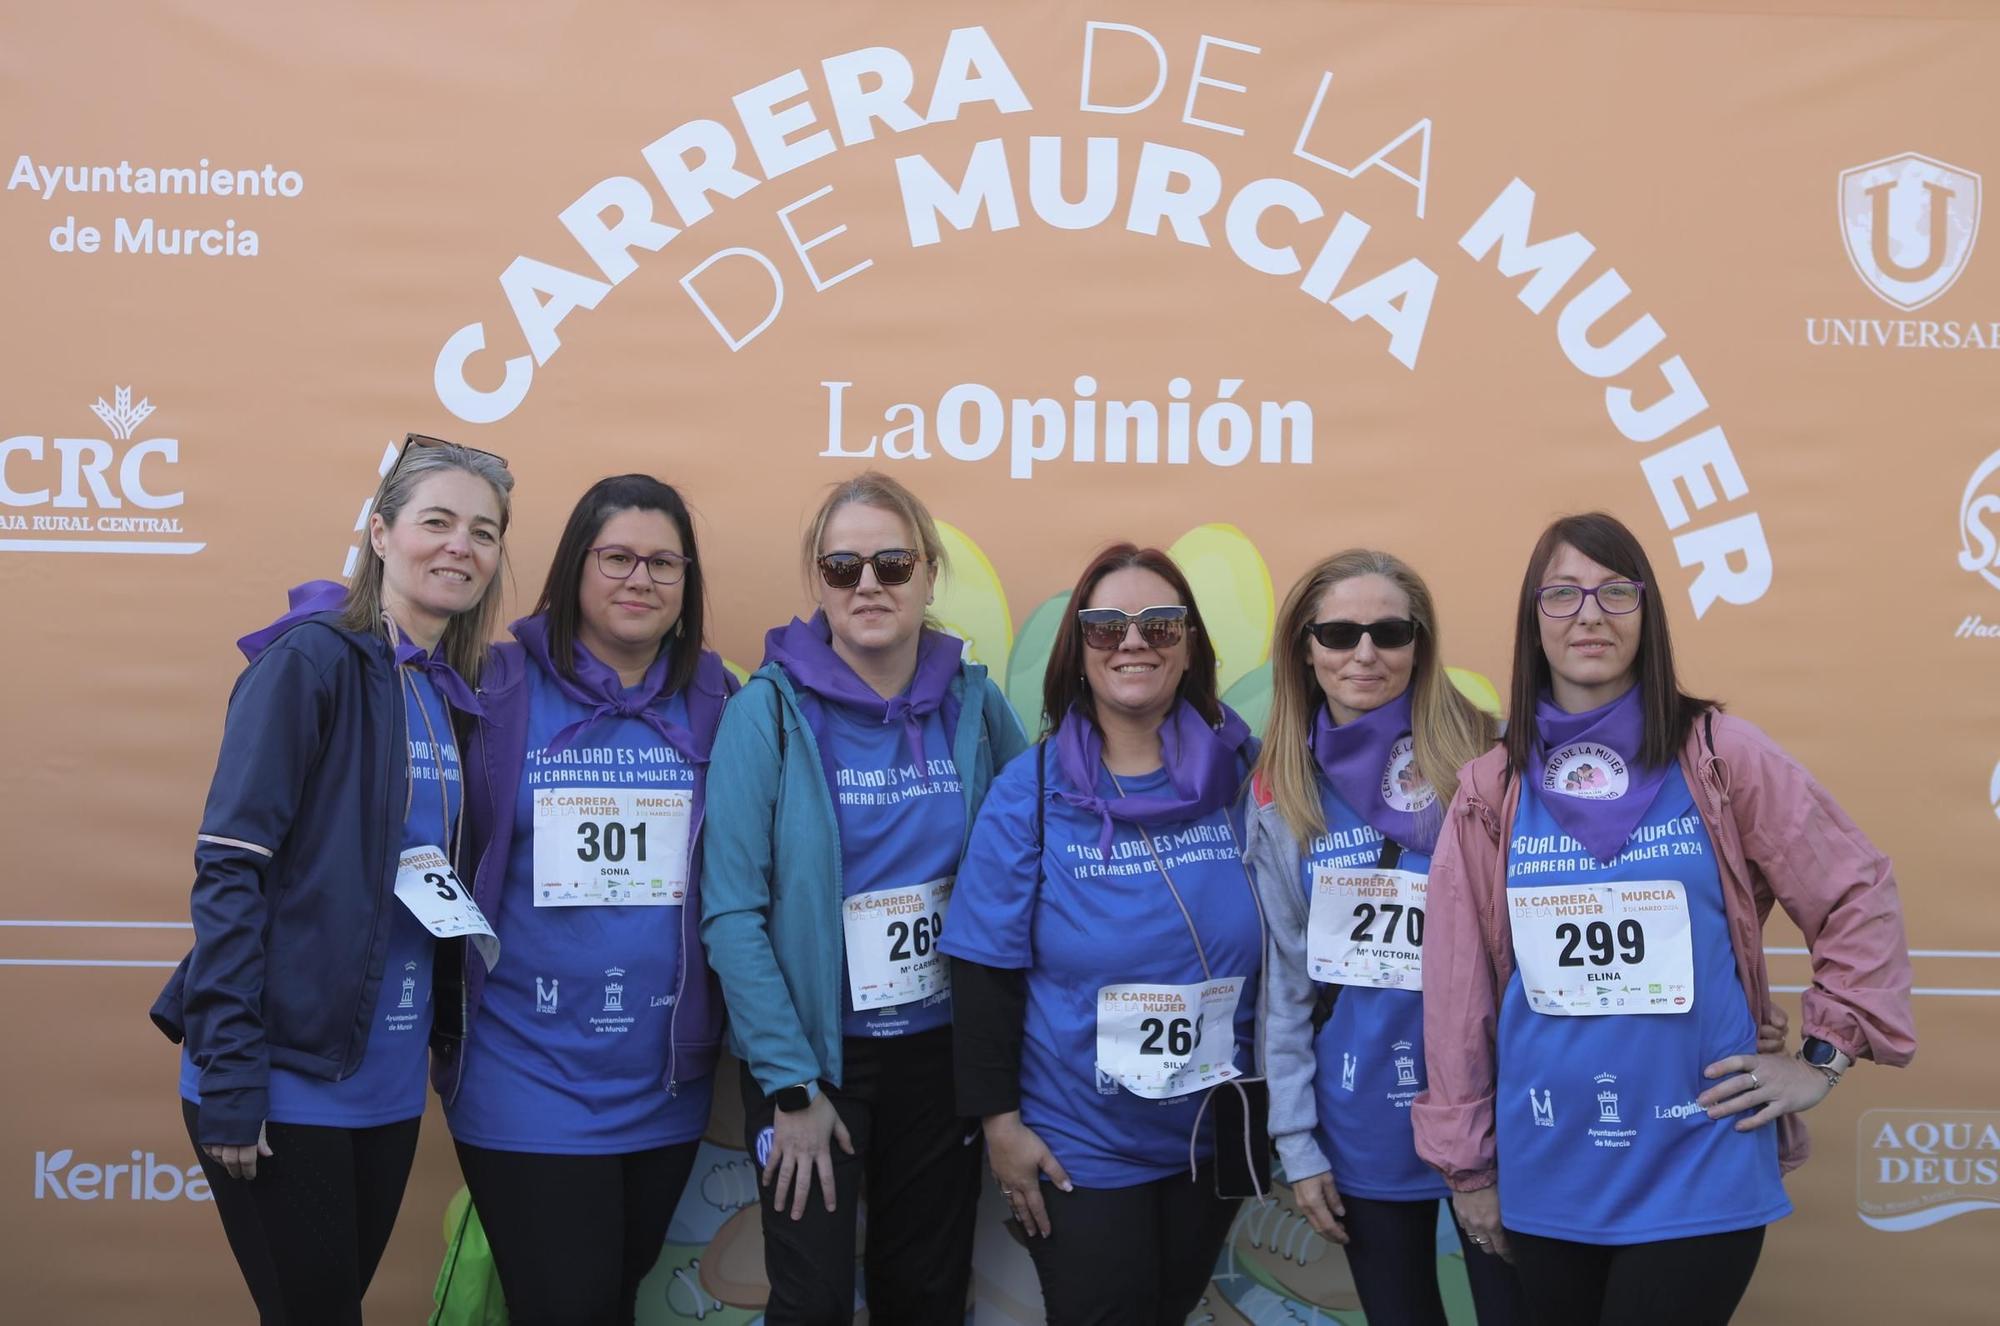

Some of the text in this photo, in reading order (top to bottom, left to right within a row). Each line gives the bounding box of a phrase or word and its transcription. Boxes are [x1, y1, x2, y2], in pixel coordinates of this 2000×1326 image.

[8, 155, 303, 199] Ayuntamiento
[49, 216, 259, 257] de Murcia
[679, 136, 1439, 370] DE MURCIA
[434, 21, 1773, 620] CARRERA DE LA MUJER
[0, 436, 184, 509] CRC
[33, 516, 94, 531] RURAL
[97, 517, 184, 533] CENTRAL
[616, 749, 635, 765] ES
[1561, 749, 1576, 759] DE
[1578, 746, 1592, 754] LA
[1595, 748, 1624, 776] MUJER
[528, 771, 541, 784] IX
[544, 769, 600, 783] CARRERA
[602, 770, 617, 783] DE
[619, 770, 634, 783] LA
[636, 769, 677, 782] MUJER
[540, 797, 684, 808] IX CARRERA MURCIA
[579, 807, 620, 816] MUJER
[577, 822, 647, 862] 301
[1154, 835, 1173, 853] ES
[1074, 865, 1088, 880] IX
[1176, 848, 1215, 866] MUJER
[1517, 858, 1576, 876] CARRERA
[1579, 857, 1597, 870] DE
[1620, 844, 1669, 864] MUJER
[1672, 841, 1703, 855] 2024
[601, 868, 630, 876] SONIA
[1320, 875, 1333, 885] IX
[1337, 877, 1395, 888] CARRERA
[1357, 888, 1398, 897] MUJER
[1515, 889, 1675, 907] IX CARRERA MURCIA
[850, 893, 922, 911] IX CARRERA
[887, 903, 925, 916] MUJER
[1556, 905, 1604, 916] MUJER
[1350, 903, 1424, 947] 270
[1555, 918, 1645, 967] 299
[1372, 949, 1420, 960] VICTORIA
[1587, 972, 1621, 982] ELINA
[1105, 992, 1118, 1001] IX
[1121, 992, 1183, 1003] CARRERA
[1143, 1003, 1186, 1013] MUJER
[590, 1016, 635, 1024] Ayuntamiento
[1588, 1128, 1637, 1138] Ayuntamiento
[1872, 1121, 2000, 1155] AQUA
[1604, 1139, 1630, 1147] Murcia
[1877, 1156, 1998, 1185] DEUS
